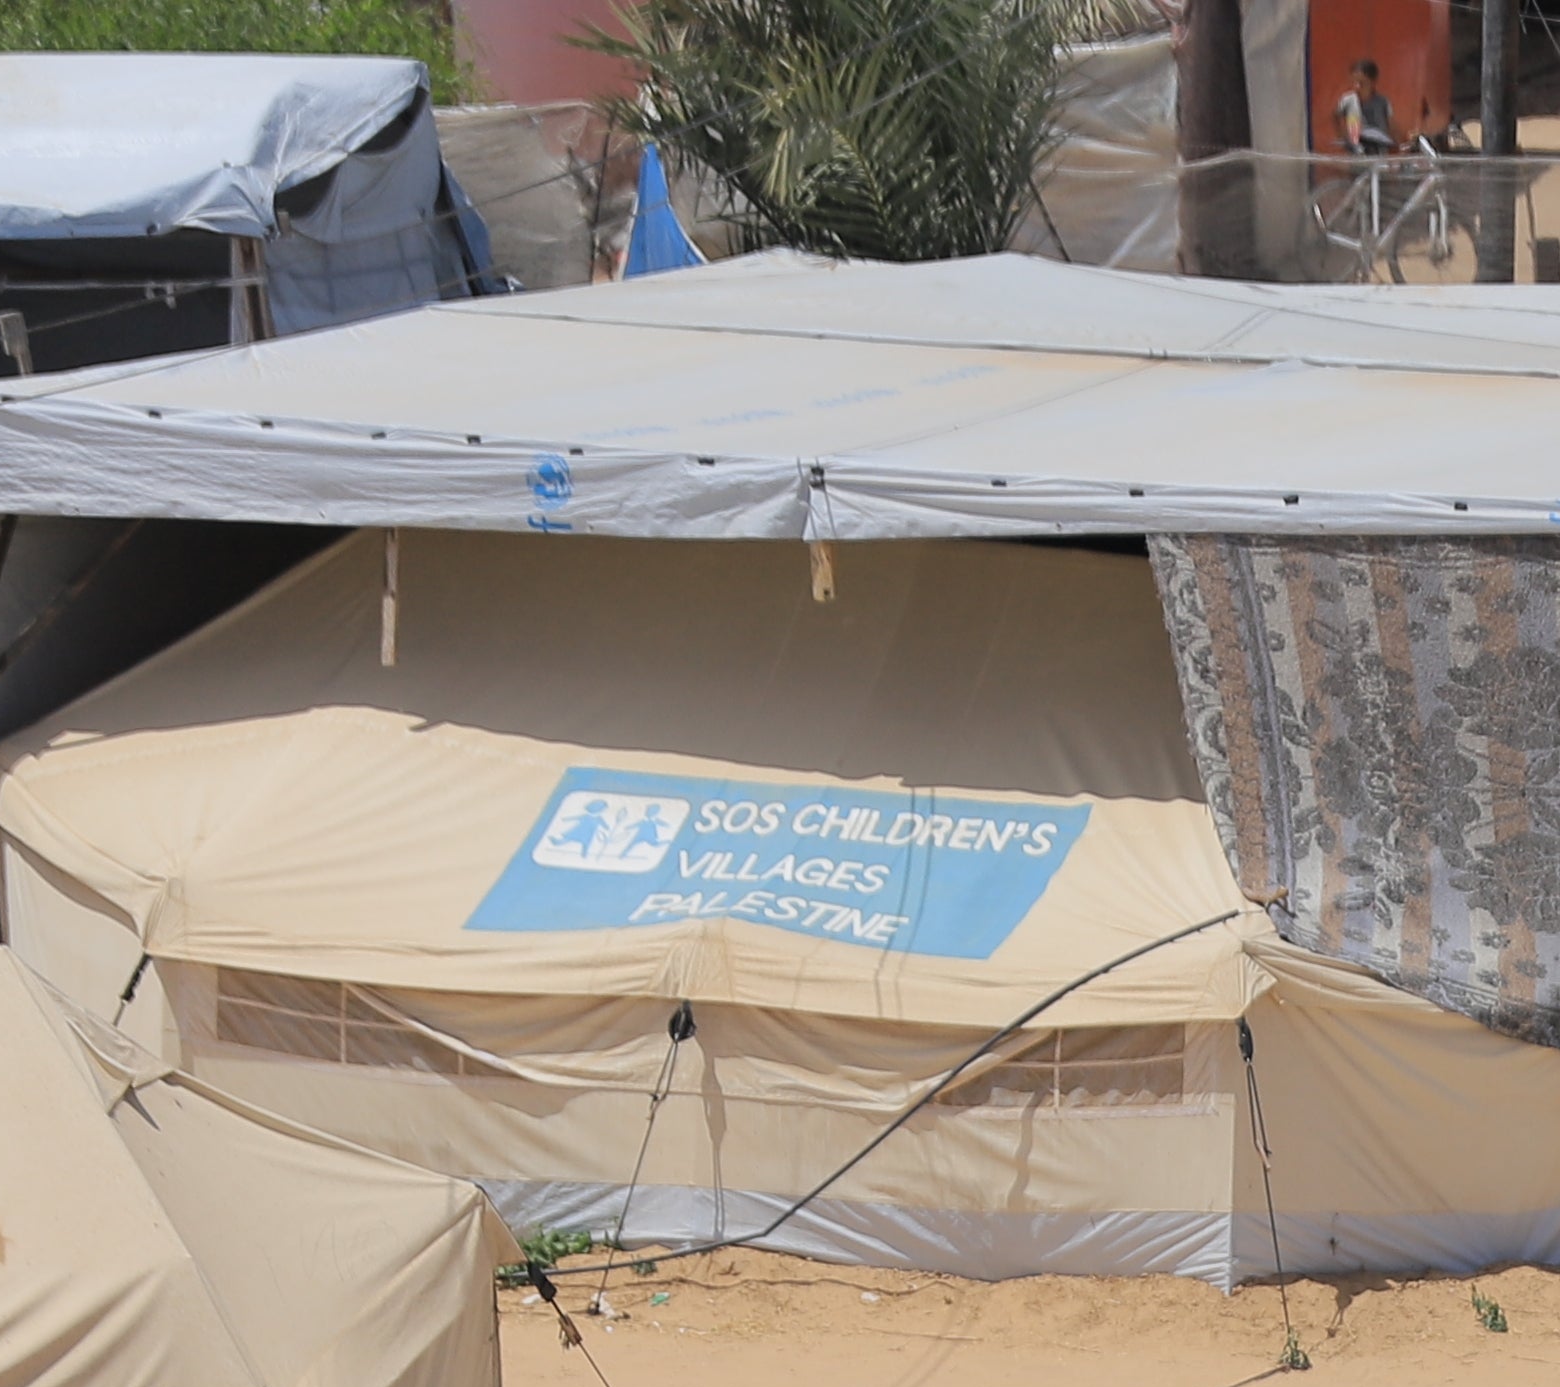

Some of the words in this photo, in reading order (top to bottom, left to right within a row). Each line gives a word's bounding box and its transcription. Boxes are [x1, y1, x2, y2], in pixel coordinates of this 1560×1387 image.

[695, 800, 786, 837] SOS
[792, 803, 1058, 856] CHILDREN'S
[678, 849, 890, 894] VILLAGES
[628, 890, 910, 943] PALESTINE
